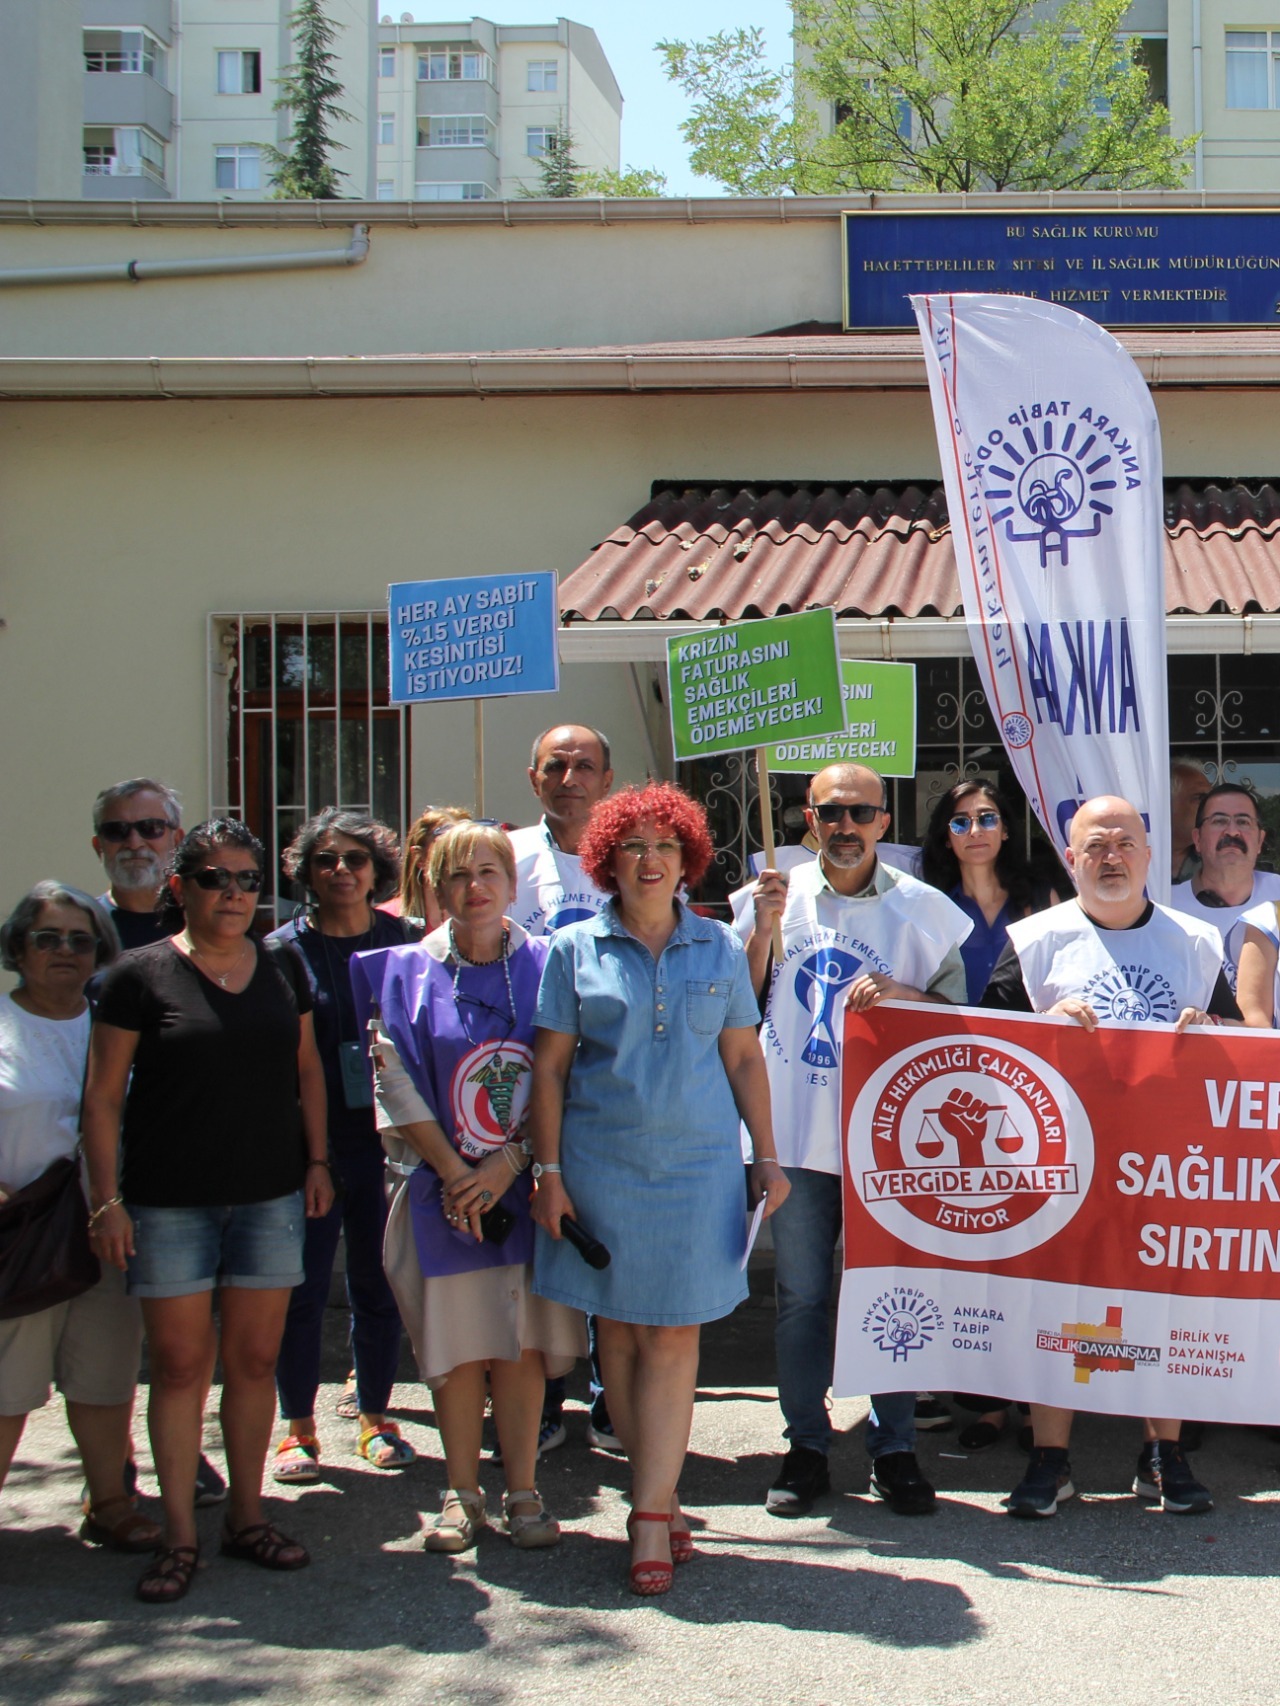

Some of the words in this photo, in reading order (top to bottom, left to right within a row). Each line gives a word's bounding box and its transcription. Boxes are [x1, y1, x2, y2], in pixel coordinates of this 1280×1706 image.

[1006, 226, 1026, 238] BU
[1032, 224, 1088, 238] SAĞLIK
[1093, 226, 1159, 238] KURUMU
[1065, 258, 1084, 270] VE
[1092, 255, 1106, 270] İL
[1109, 255, 1160, 270] SAĞLIK
[1050, 287, 1111, 301] HİZMET
[1121, 286, 1228, 301] VERMEKTEDİR
[398, 599, 439, 627] HER
[442, 594, 472, 619] AY
[476, 581, 538, 611] SABİT
[401, 619, 448, 647] %15
[452, 607, 516, 639] VERGİ
[404, 632, 506, 672] KESİNTİSİ
[678, 631, 739, 664] KRİZİN
[681, 640, 790, 684] FATURASINI
[407, 655, 523, 695] İSTİYORUZ!
[684, 671, 750, 704] SAĞLIK
[687, 679, 798, 728] EMEKÇİLERİ
[690, 697, 824, 745] ÖDEMEYECEK!
[522, 906, 546, 931] SYAL
[851, 938, 895, 980] EMEKÇİ
[1081, 970, 1110, 1003] NKARA
[873, 1101, 899, 1142] AİLE
[888, 1046, 973, 1102] HEKİMLİĞİ
[977, 1052, 1063, 1144] ÇALIŞANLARI
[870, 1170, 973, 1197] VERGİDE
[979, 1168, 1071, 1192] ADALET
[935, 1203, 1011, 1229] İSTİYOR
[861, 1291, 890, 1333] ANKARA
[893, 1287, 924, 1299] TABİP
[926, 1298, 945, 1330] ODASI
[953, 1306, 1005, 1322] ANKARA
[952, 1321, 990, 1335] TABİP
[1169, 1328, 1211, 1345] BİRLİK
[1214, 1331, 1230, 1345] VE
[952, 1338, 992, 1352] ODASI
[1167, 1346, 1247, 1366] DAYANIŞMA
[1166, 1361, 1233, 1379] SENDİKASI
